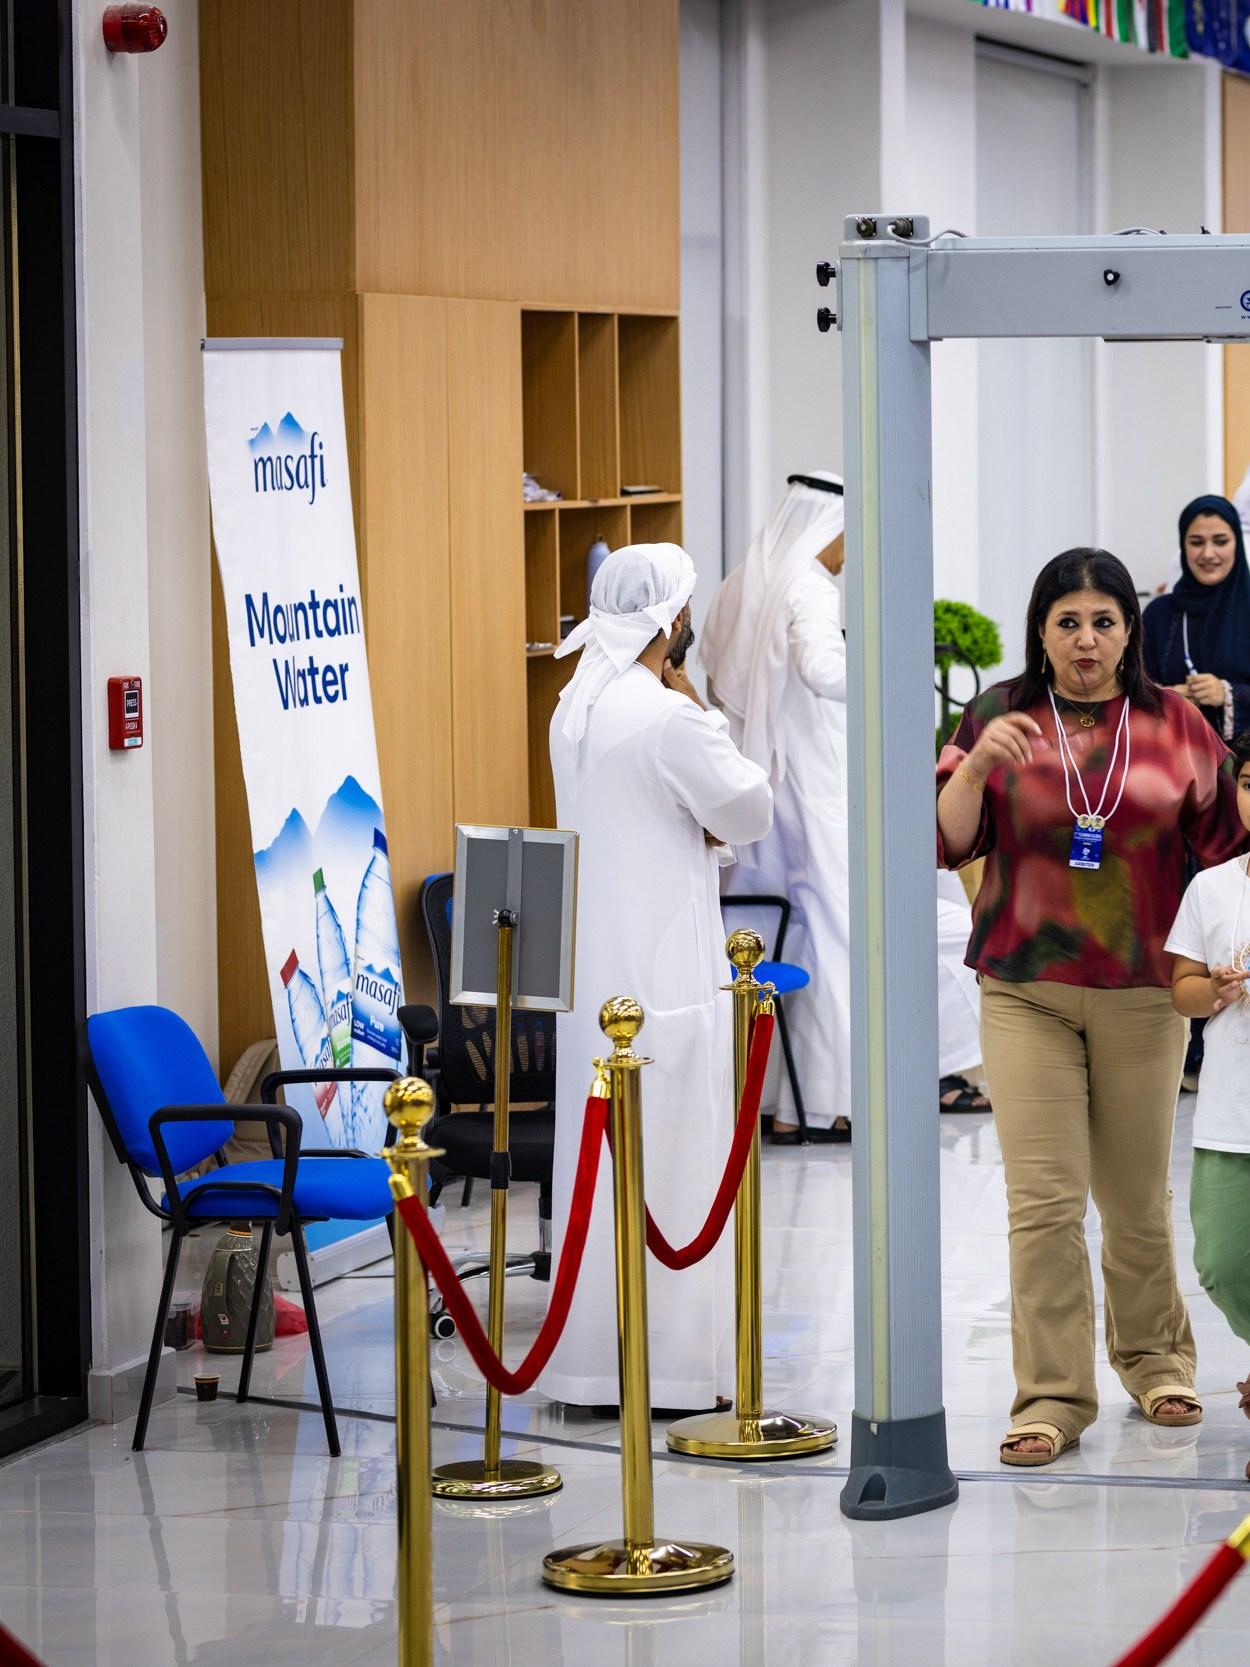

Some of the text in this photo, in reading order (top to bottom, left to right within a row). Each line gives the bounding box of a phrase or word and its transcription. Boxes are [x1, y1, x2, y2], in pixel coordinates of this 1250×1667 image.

[254, 431, 326, 505] masafi
[244, 584, 360, 647] Mountain
[272, 656, 348, 710] Water
[370, 1014, 384, 1032] Pure
